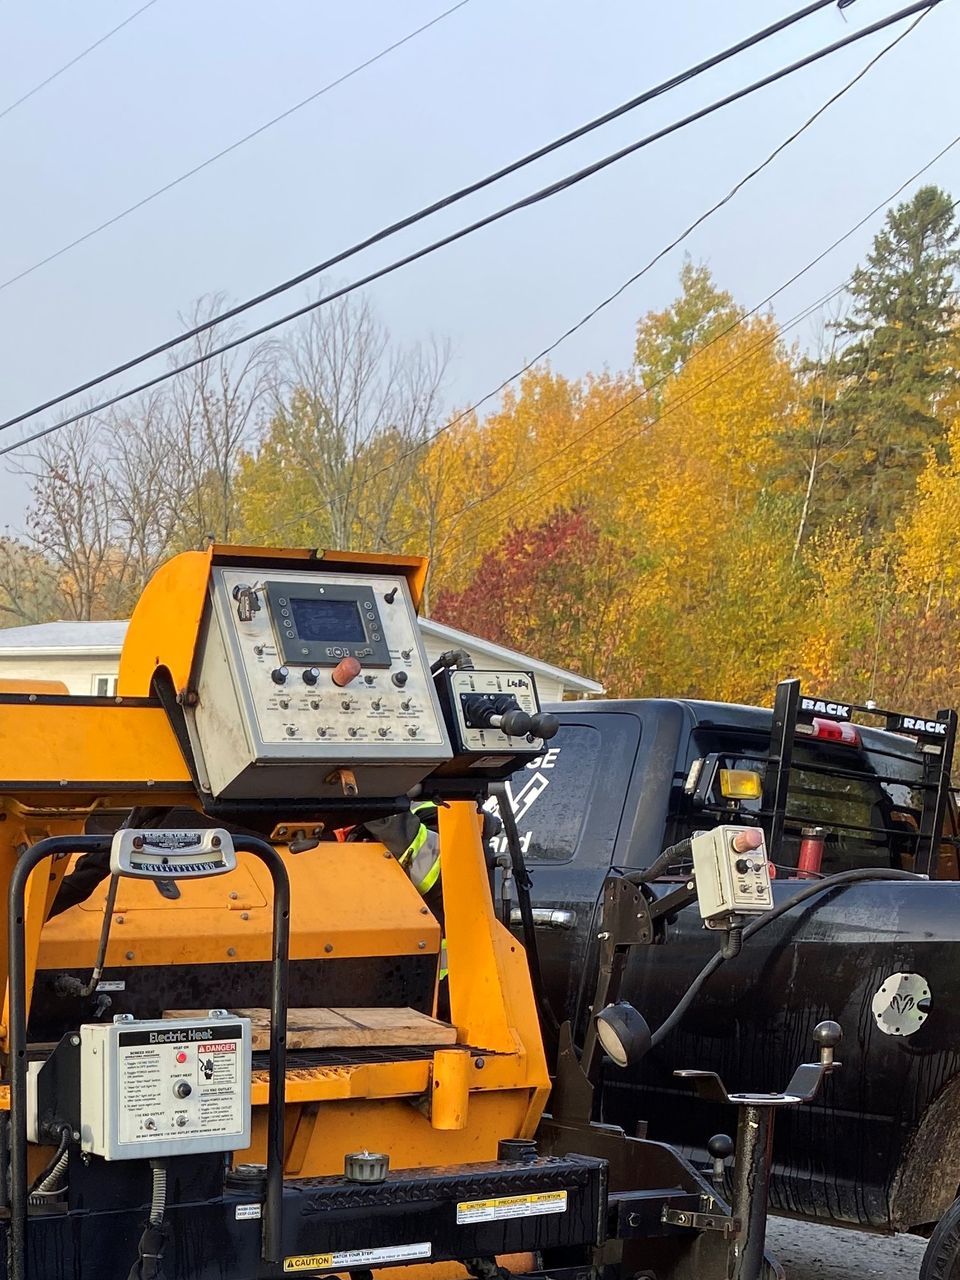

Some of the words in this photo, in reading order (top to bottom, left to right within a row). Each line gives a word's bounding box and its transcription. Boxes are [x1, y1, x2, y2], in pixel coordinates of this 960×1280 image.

[903, 716, 947, 734] RACK
[149, 1031, 187, 1043] Electric
[188, 1028, 213, 1040] Heat
[205, 1043, 235, 1052] DANGER
[294, 1256, 330, 1267] CAUTION
